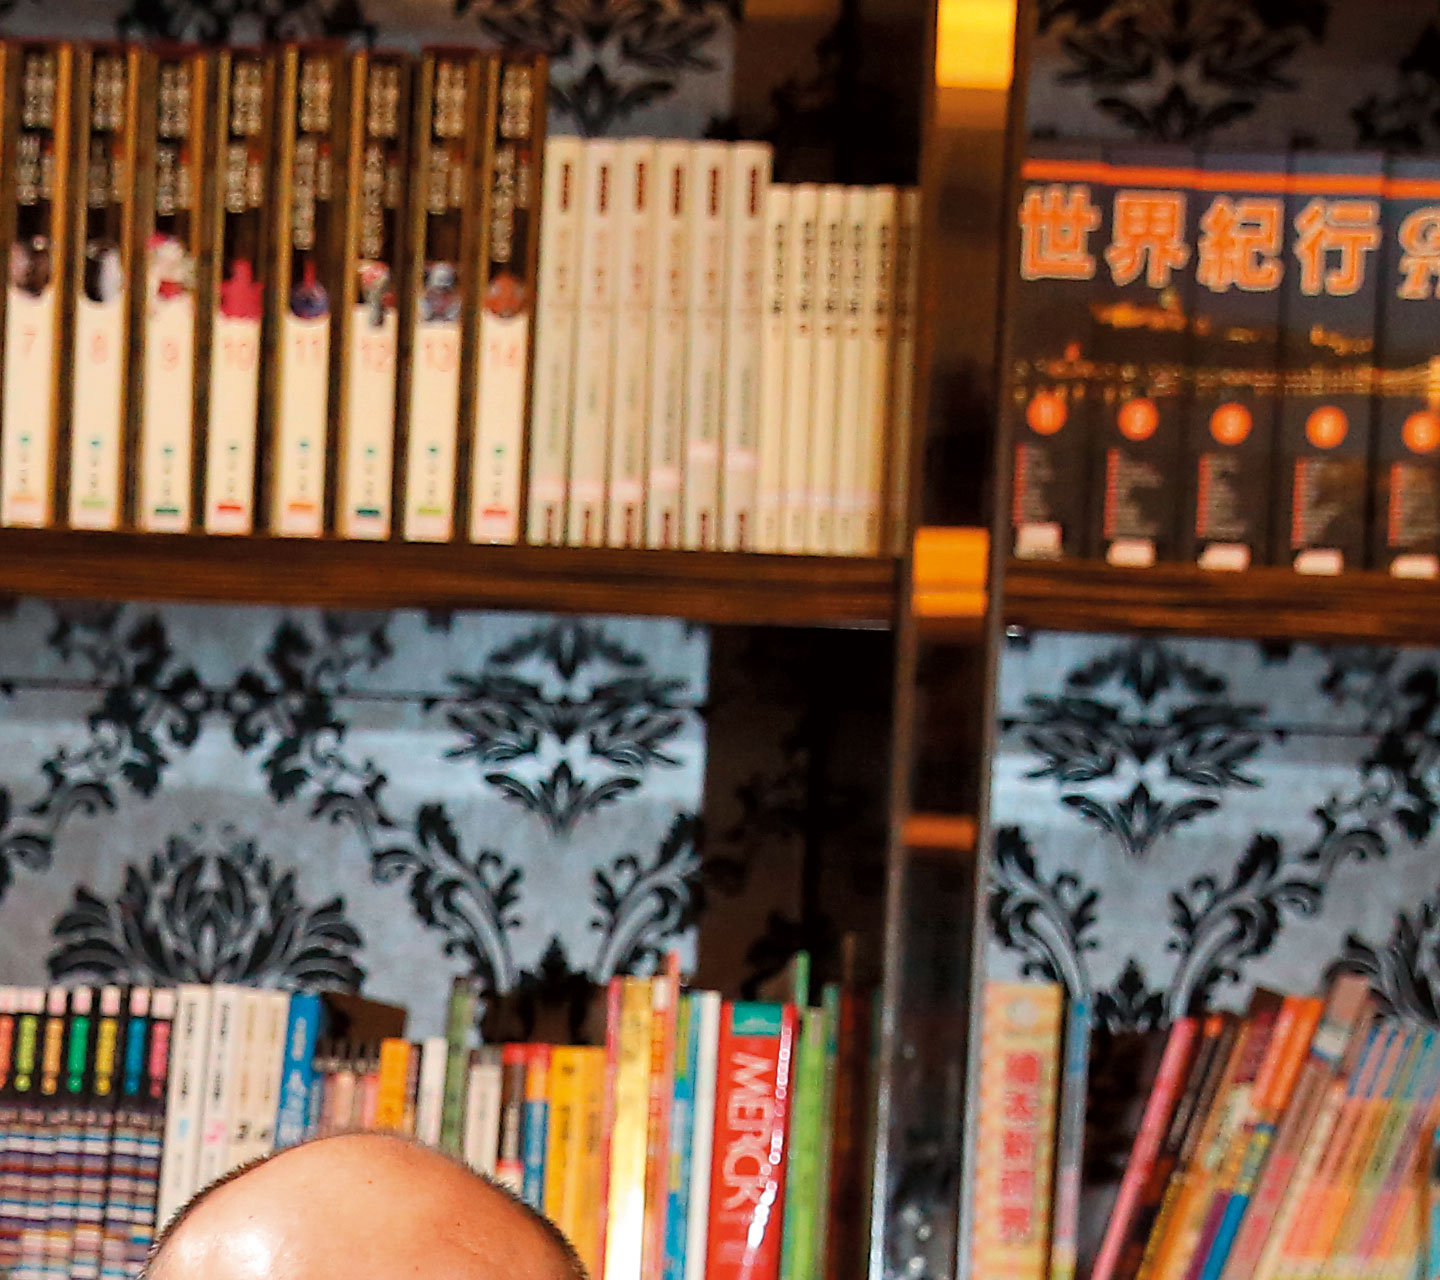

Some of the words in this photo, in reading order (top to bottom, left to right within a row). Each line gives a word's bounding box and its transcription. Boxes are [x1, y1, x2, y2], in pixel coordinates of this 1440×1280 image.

[1019, 184, 1382, 296] 世界紀行
[721, 1051, 775, 1211] MERCK
